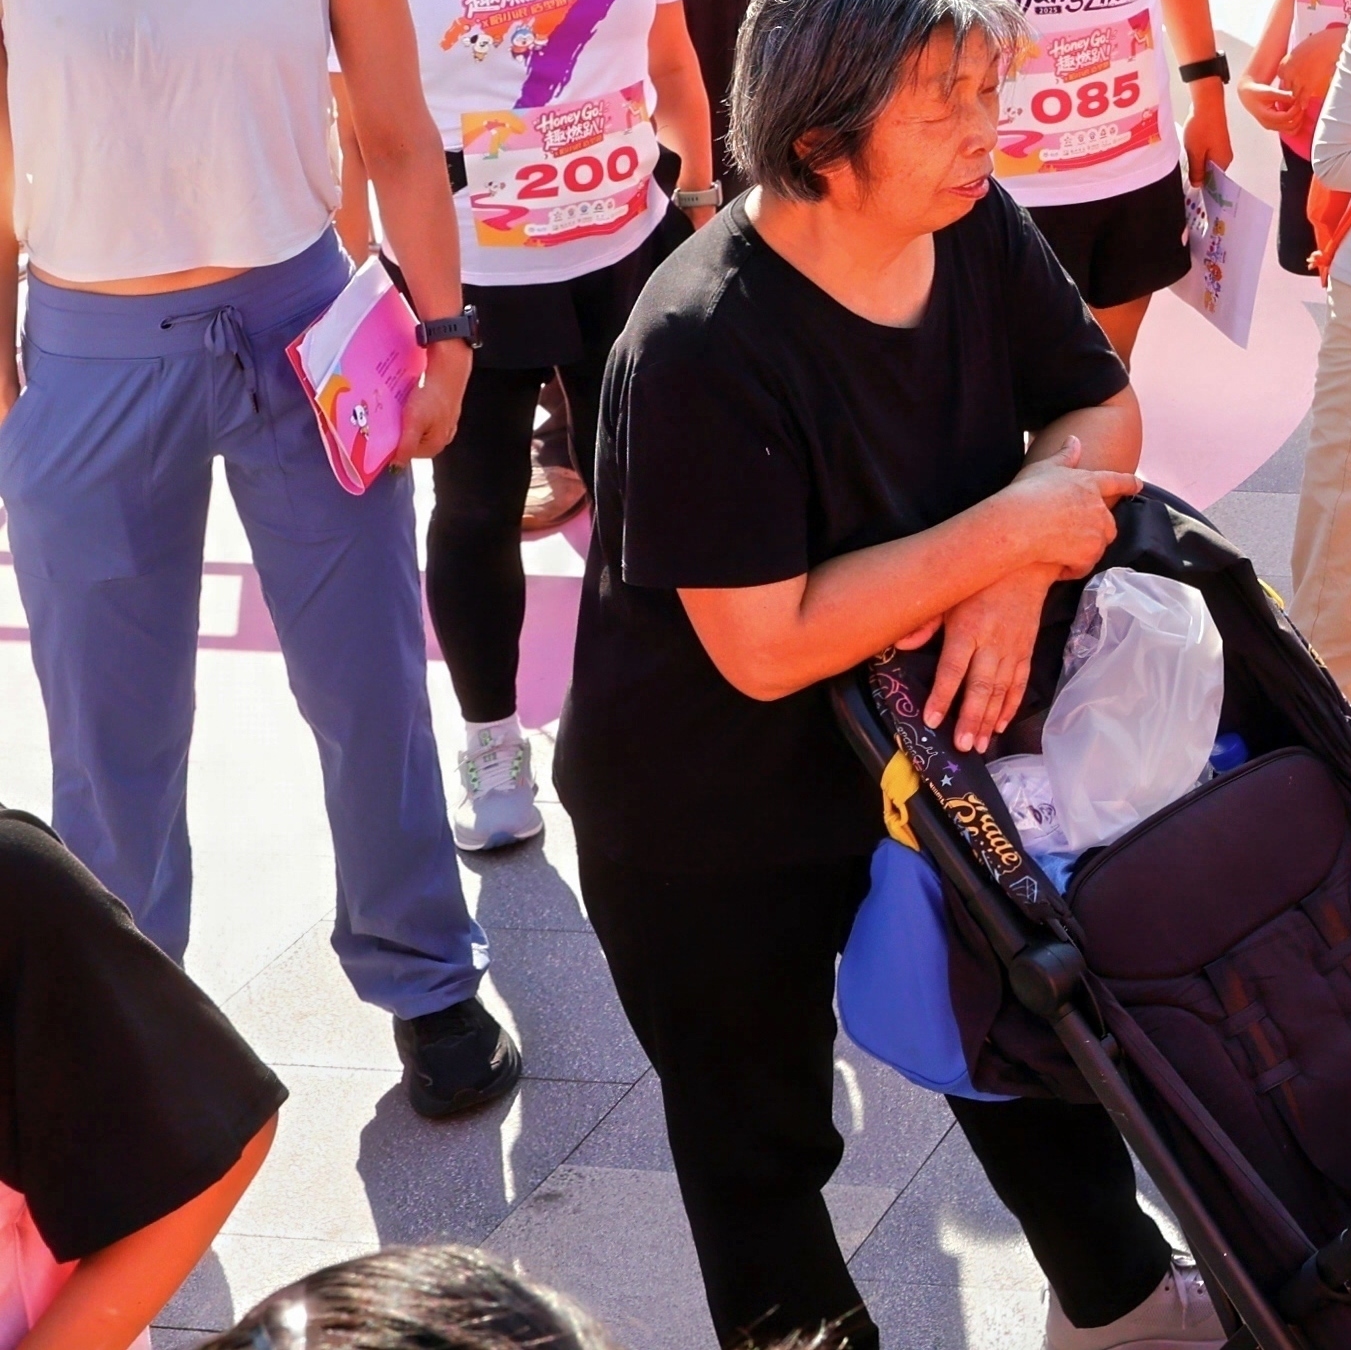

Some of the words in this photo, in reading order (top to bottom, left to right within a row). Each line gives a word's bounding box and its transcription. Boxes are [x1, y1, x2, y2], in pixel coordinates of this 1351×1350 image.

[1038, 6, 1059, 14] 2025
[1048, 34, 1090, 58] Honey
[1090, 28, 1111, 46] Go!
[1030, 70, 1141, 125] 085
[535, 110, 581, 134] Honey
[581, 101, 605, 122] Go!
[515, 145, 639, 201] 200
